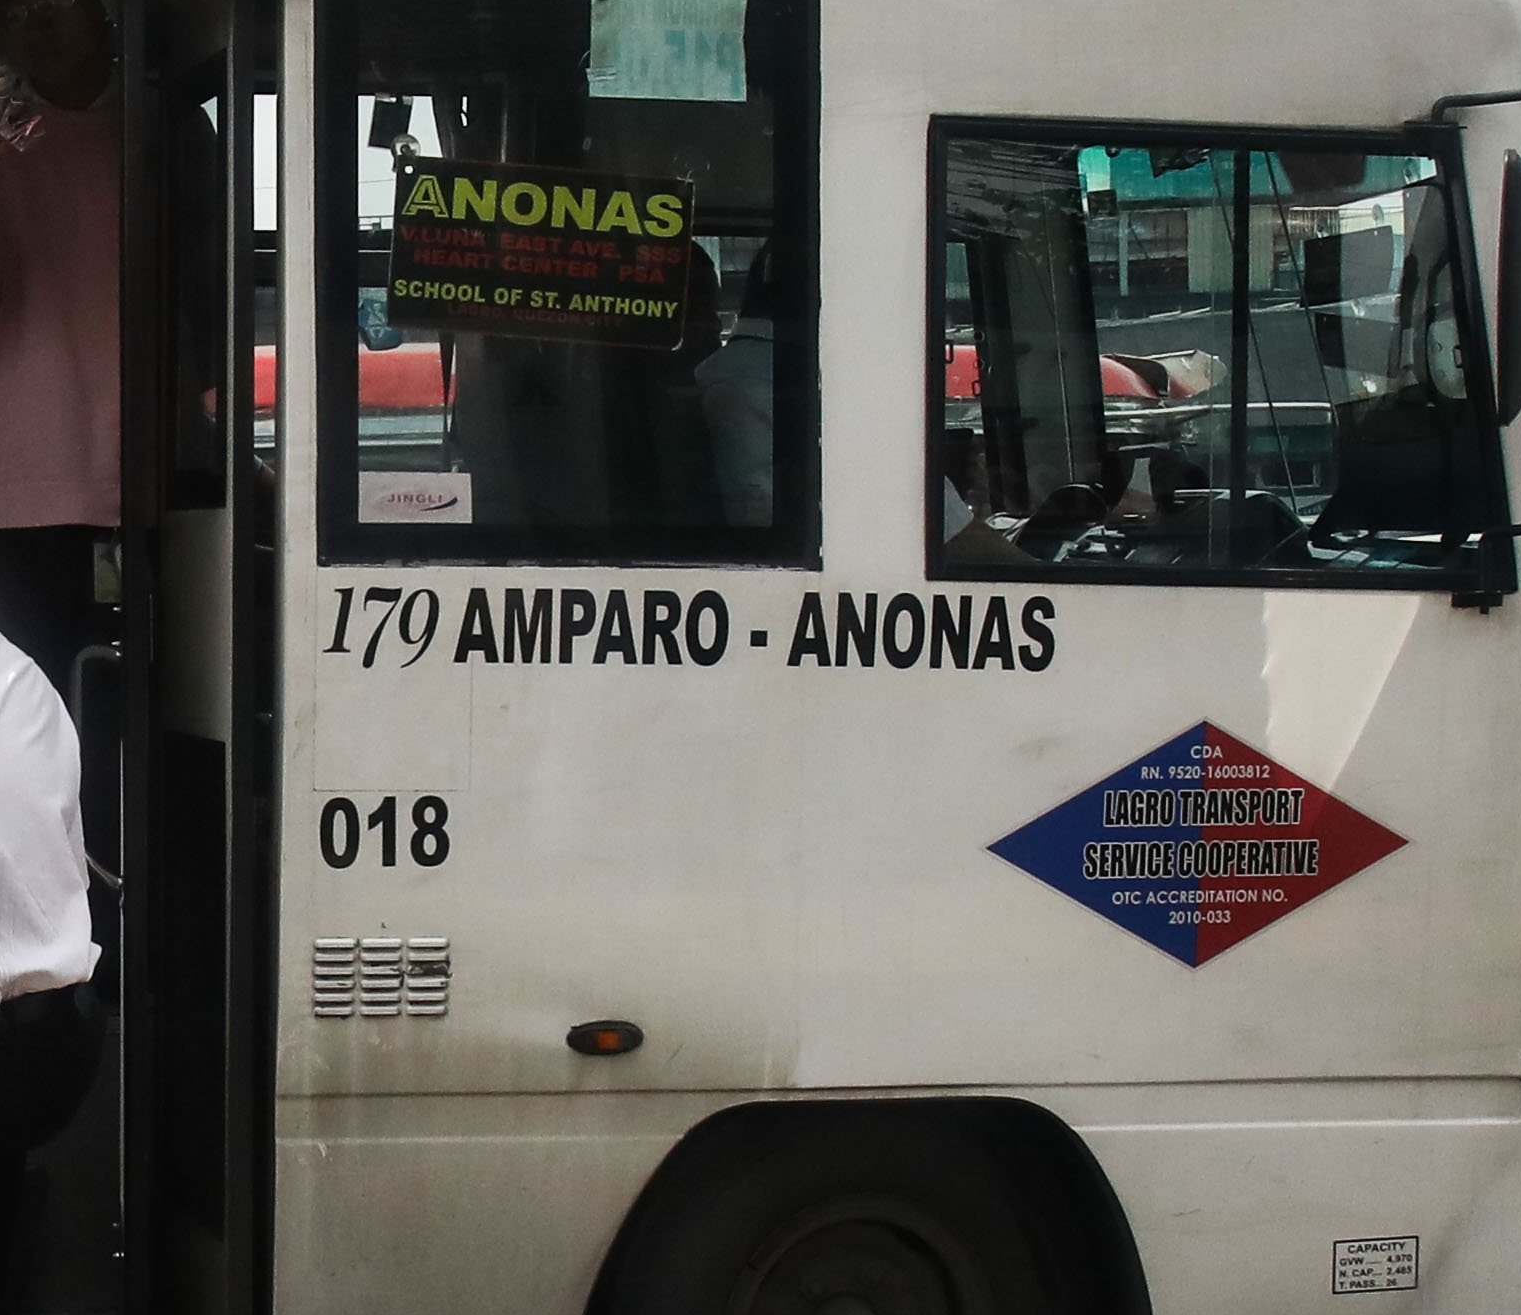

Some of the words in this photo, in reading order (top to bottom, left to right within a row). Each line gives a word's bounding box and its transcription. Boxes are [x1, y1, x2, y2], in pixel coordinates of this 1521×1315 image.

[402, 174, 684, 238] ANONAS
[413, 247, 493, 270] HEART
[501, 254, 599, 279] CENTER
[618, 264, 665, 284] PSA
[499, 231, 563, 255] EAST
[636, 243, 683, 266] SSS
[394, 279, 485, 304] SCHOOL
[494, 288, 522, 307] OF
[530, 290, 560, 310] ST.
[569, 293, 679, 319] ANTHONY
[388, 494, 443, 503] JINGLI
[321, 587, 440, 669] 179
[453, 587, 729, 666] AMPARO
[787, 592, 1057, 673] ANONAS
[1190, 745, 1223, 759] CDA
[1140, 767, 1164, 780] RN.
[1168, 765, 1271, 779] 9520-16003812
[1103, 789, 1174, 827] LAGRO
[1178, 788, 1304, 826] TRANSPORT
[318, 795, 451, 869] 018
[1083, 841, 1174, 879] SERVICE
[1176, 839, 1319, 878] COOPERATIVE
[1111, 890, 1142, 906] OTC
[1145, 889, 1259, 905] ACCREDITATION
[1262, 889, 1289, 904] NO.
[1168, 910, 1232, 925] 2010-033
[1339, 1257, 1364, 1266] GVW
[1348, 1242, 1406, 1253] CAPACITY
